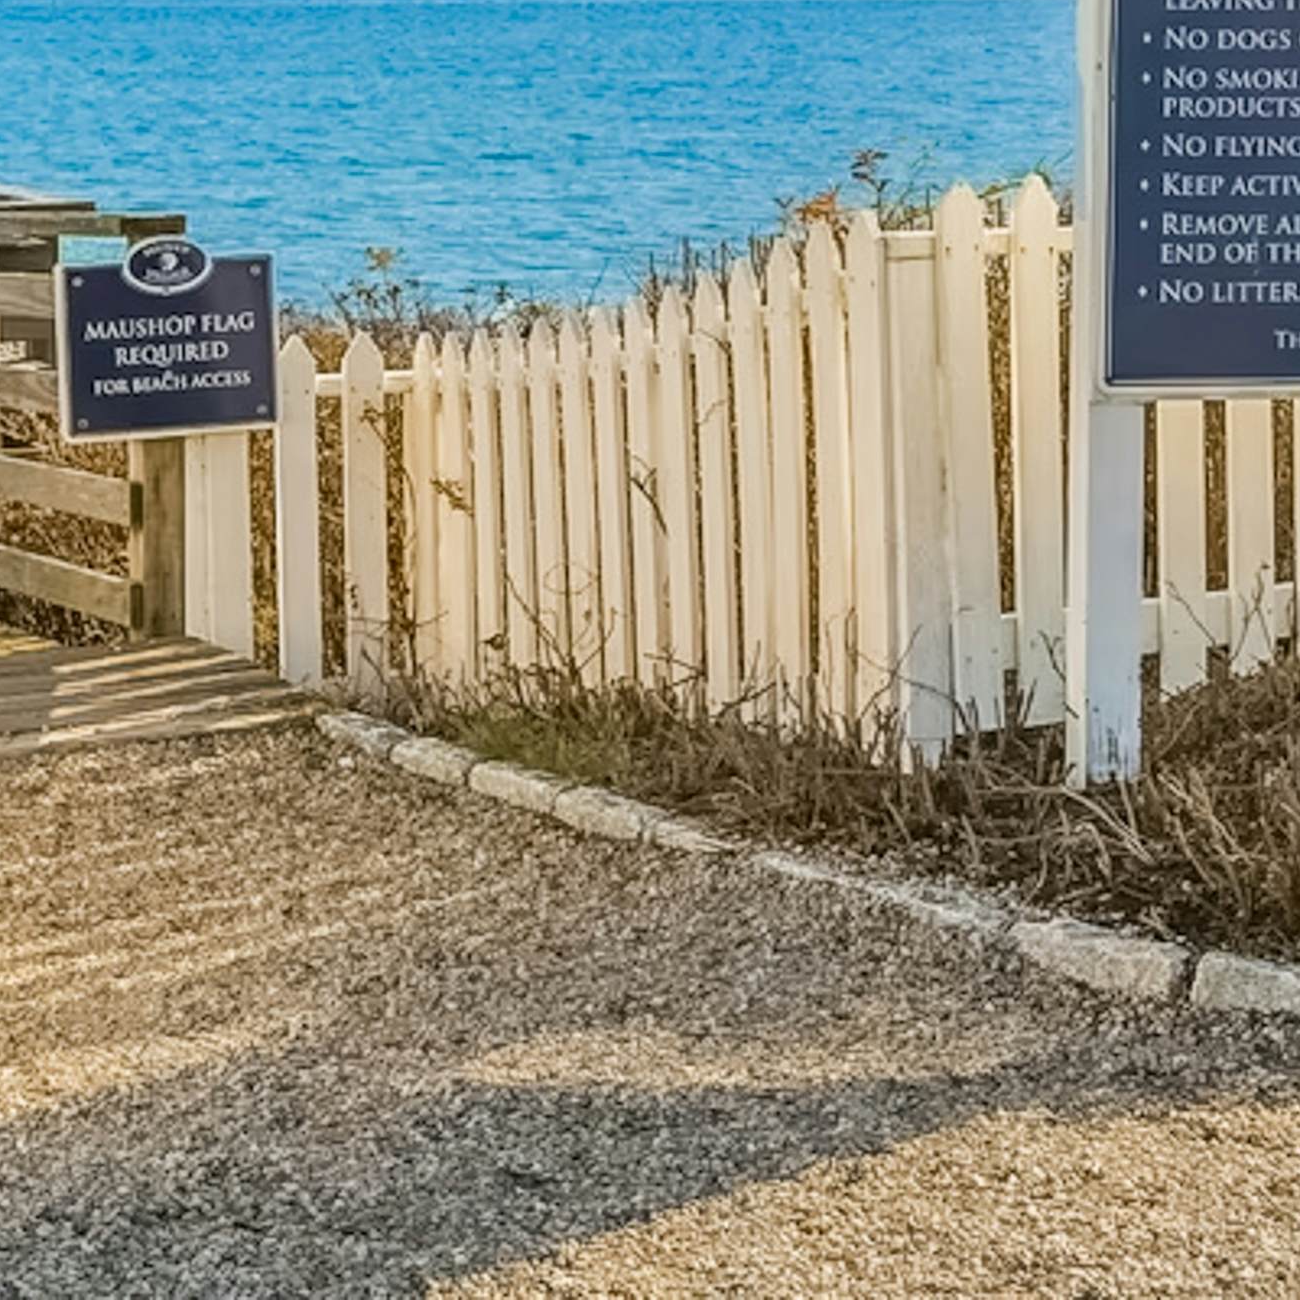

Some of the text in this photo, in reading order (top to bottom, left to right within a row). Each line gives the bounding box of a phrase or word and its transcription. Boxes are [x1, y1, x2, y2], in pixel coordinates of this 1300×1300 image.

[1218, 29, 1291, 50] DOGS
[1160, 243, 1216, 264] END
[1224, 243, 1259, 264] OF
[84, 311, 255, 341] MAUSHOP FLAG
[115, 340, 229, 367] REQUIRED
[94, 370, 251, 396] FOR BEACH ACCESS
